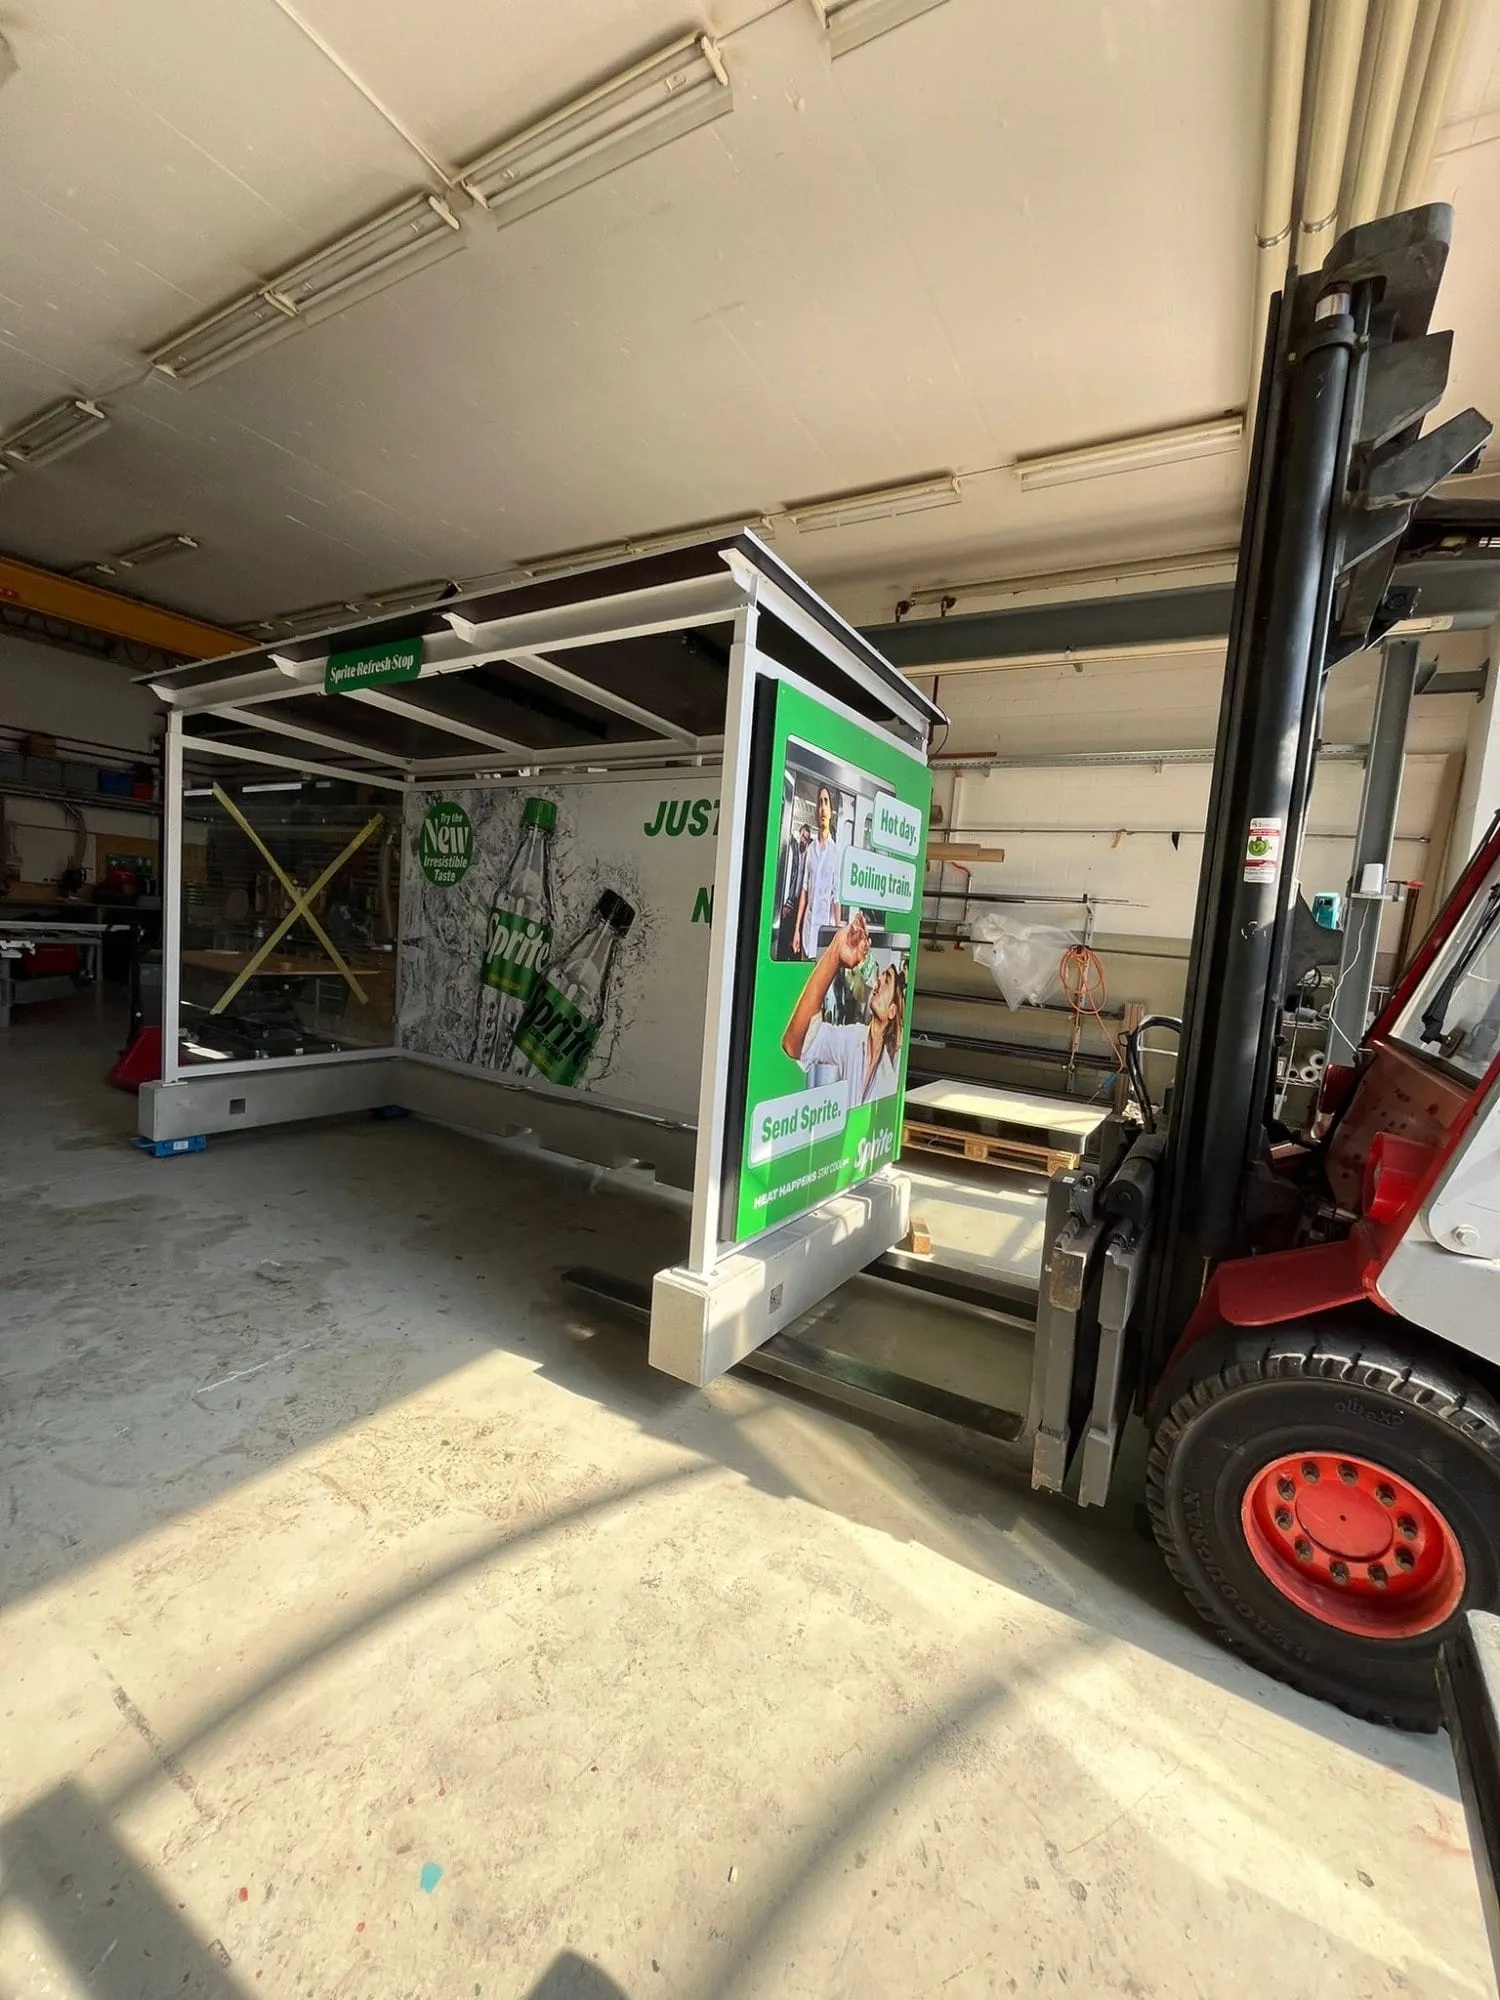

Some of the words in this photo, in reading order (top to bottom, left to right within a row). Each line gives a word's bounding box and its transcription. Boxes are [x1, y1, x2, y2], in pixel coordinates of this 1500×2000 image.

[330, 664, 355, 684] Sprite
[356, 657, 391, 677] Refresh
[391, 654, 414, 670] Stop
[424, 818, 469, 854] New
[440, 813, 451, 825] Try
[451, 813, 463, 823] the
[880, 808, 899, 835] Hot
[899, 817, 917, 846] day.
[423, 855, 468, 868] Irresistible
[434, 869, 456, 882] Taste
[850, 862, 888, 897] Boiling
[888, 873, 912, 897] train.
[485, 912, 550, 974] Sprite
[761, 1107, 798, 1143] Send
[800, 1098, 841, 1132] Sprite.
[854, 1127, 894, 1172] Sprite
[754, 1188, 778, 1209] HEAT
[778, 1170, 817, 1197] HAPPENS
